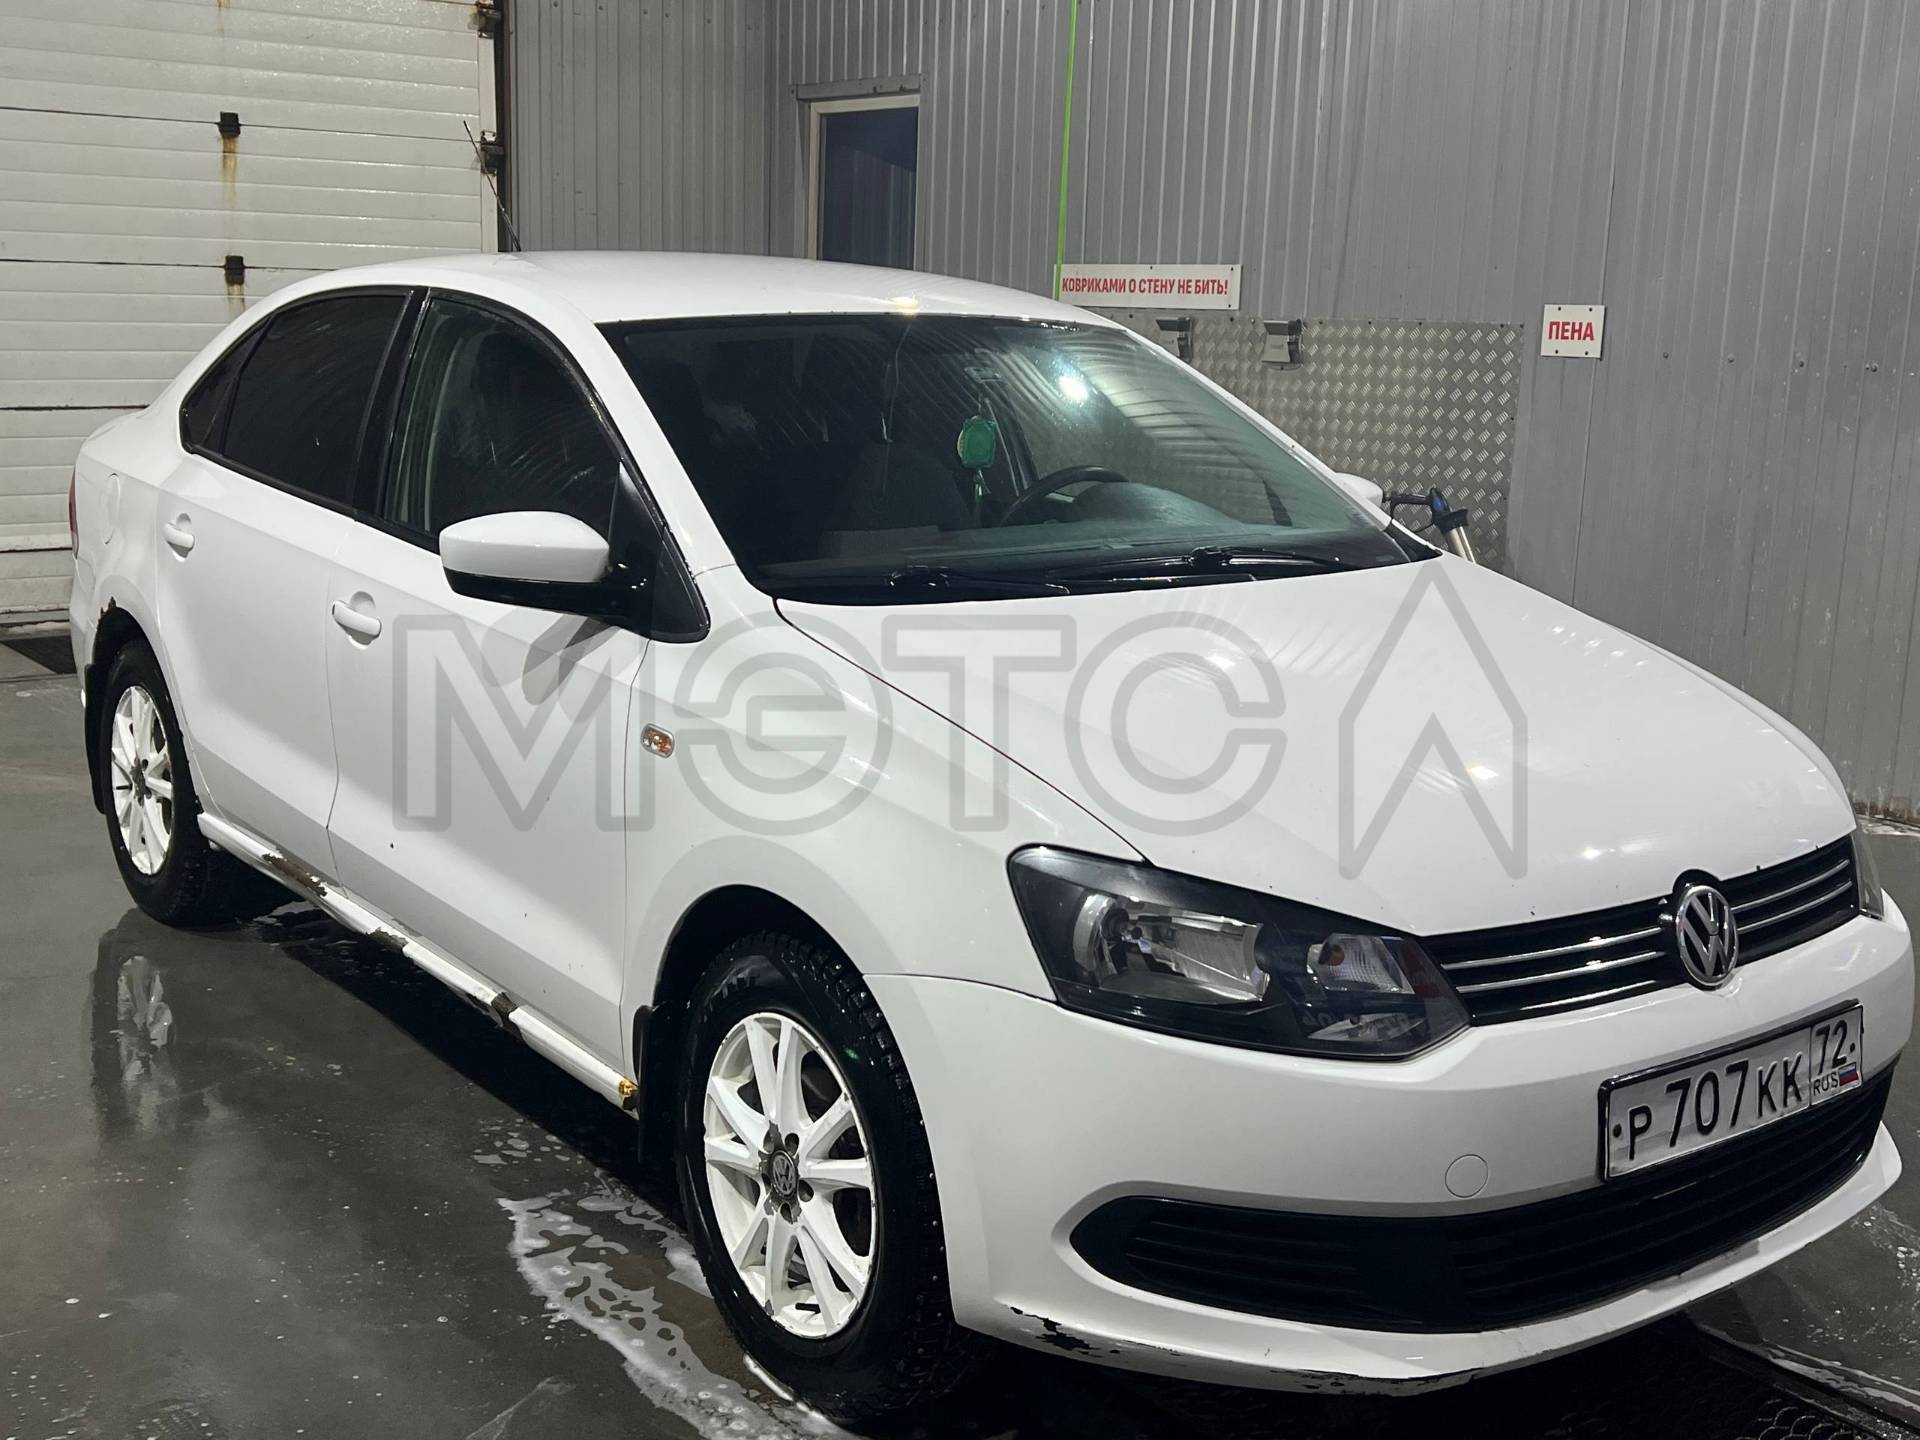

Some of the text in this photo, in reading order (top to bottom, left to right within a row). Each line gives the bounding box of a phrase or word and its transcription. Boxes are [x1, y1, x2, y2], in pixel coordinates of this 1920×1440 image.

[1062, 277, 1229, 295] КОВРИКАМИ О СТЕНУ НЕ БИТЬ!
[1548, 321, 1595, 341] ПЕНА
[1815, 1019, 1848, 1076] 72
[1812, 1071, 1839, 1097] RUS
